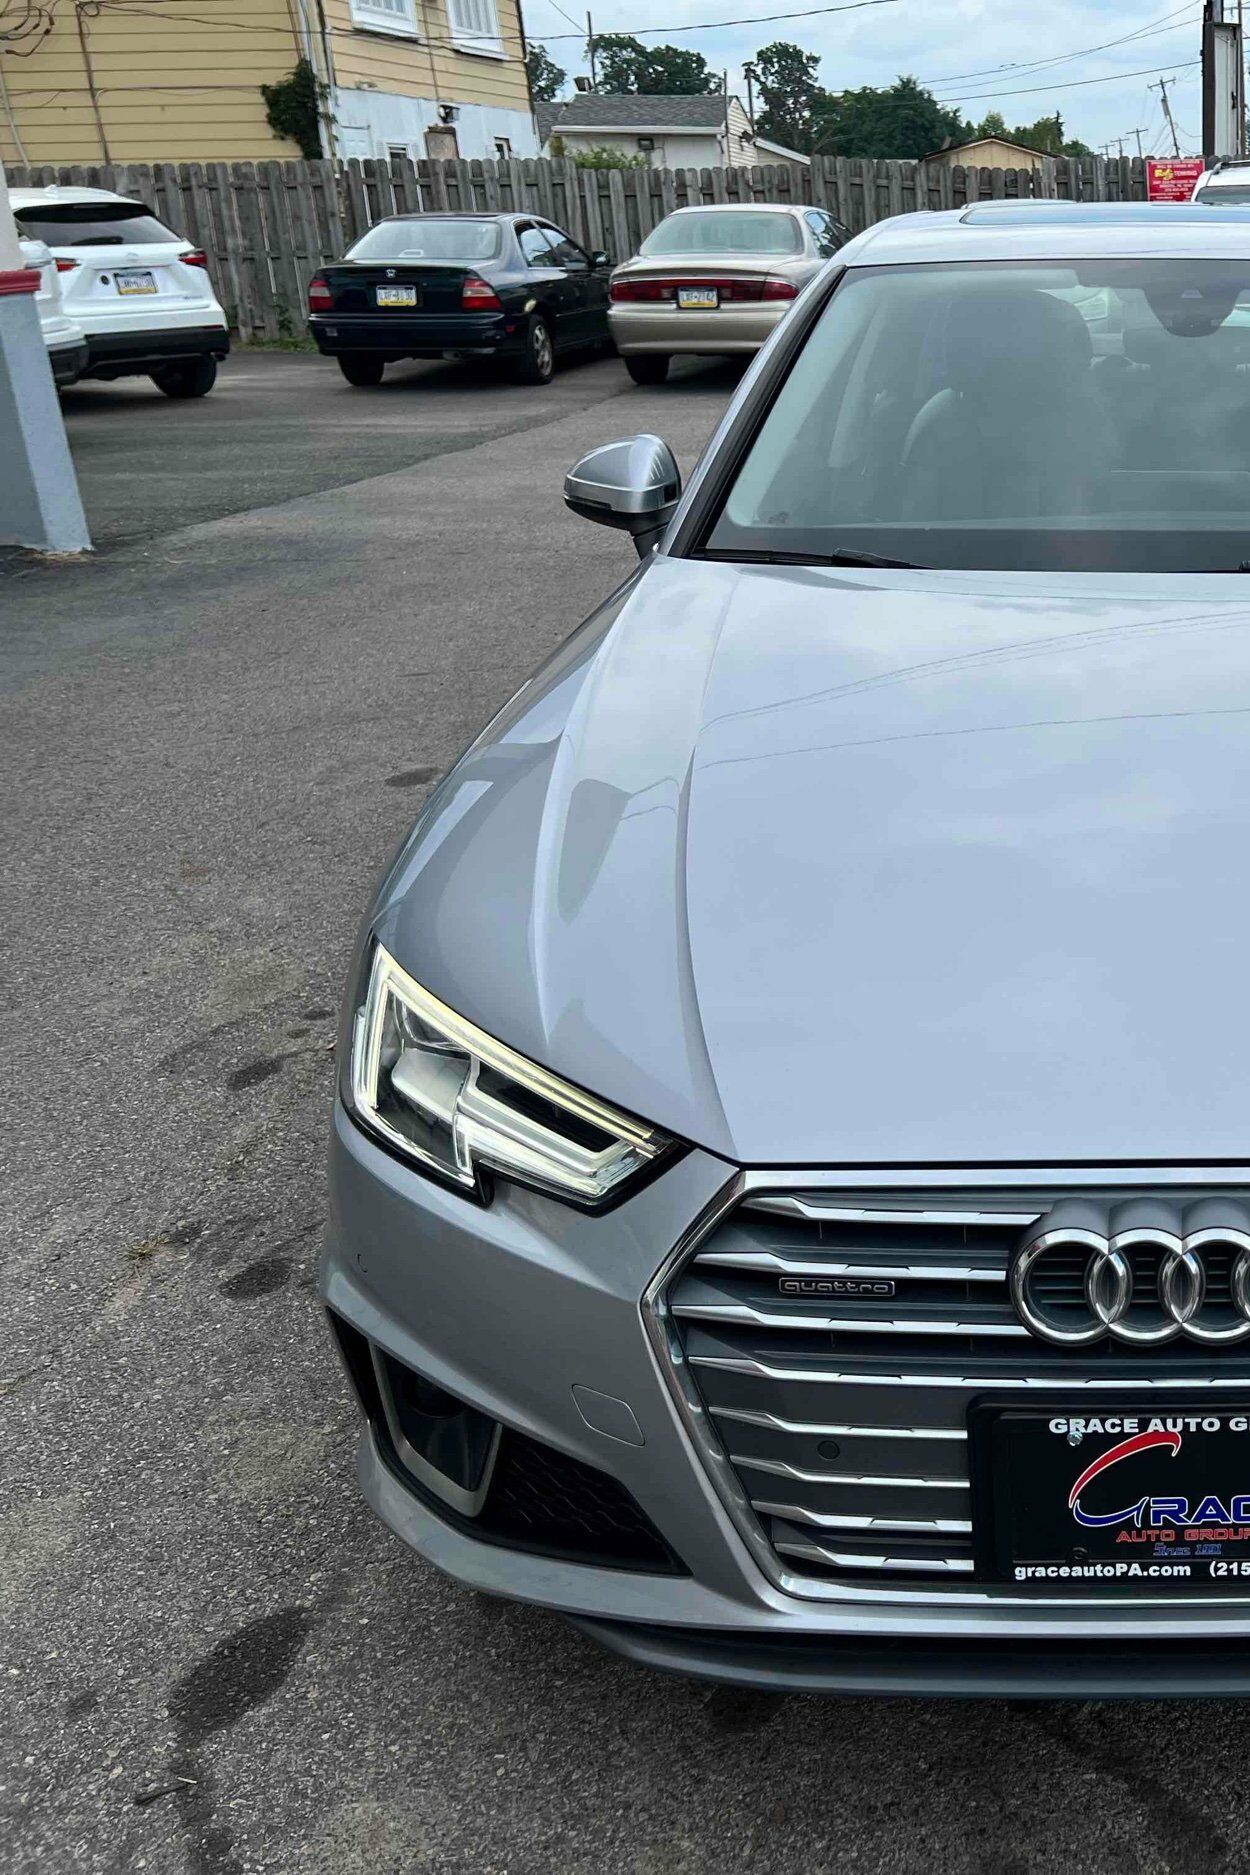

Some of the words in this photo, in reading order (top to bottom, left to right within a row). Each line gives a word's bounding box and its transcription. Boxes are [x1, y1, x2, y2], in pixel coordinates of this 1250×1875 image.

[784, 1281, 889, 1293] quattro
[1049, 1418, 1139, 1433] GRACE
[1147, 1417, 1221, 1432] AUTO
[1116, 1529, 1176, 1542] AUTO
[1014, 1564, 1191, 1580] graceautoPA.com
